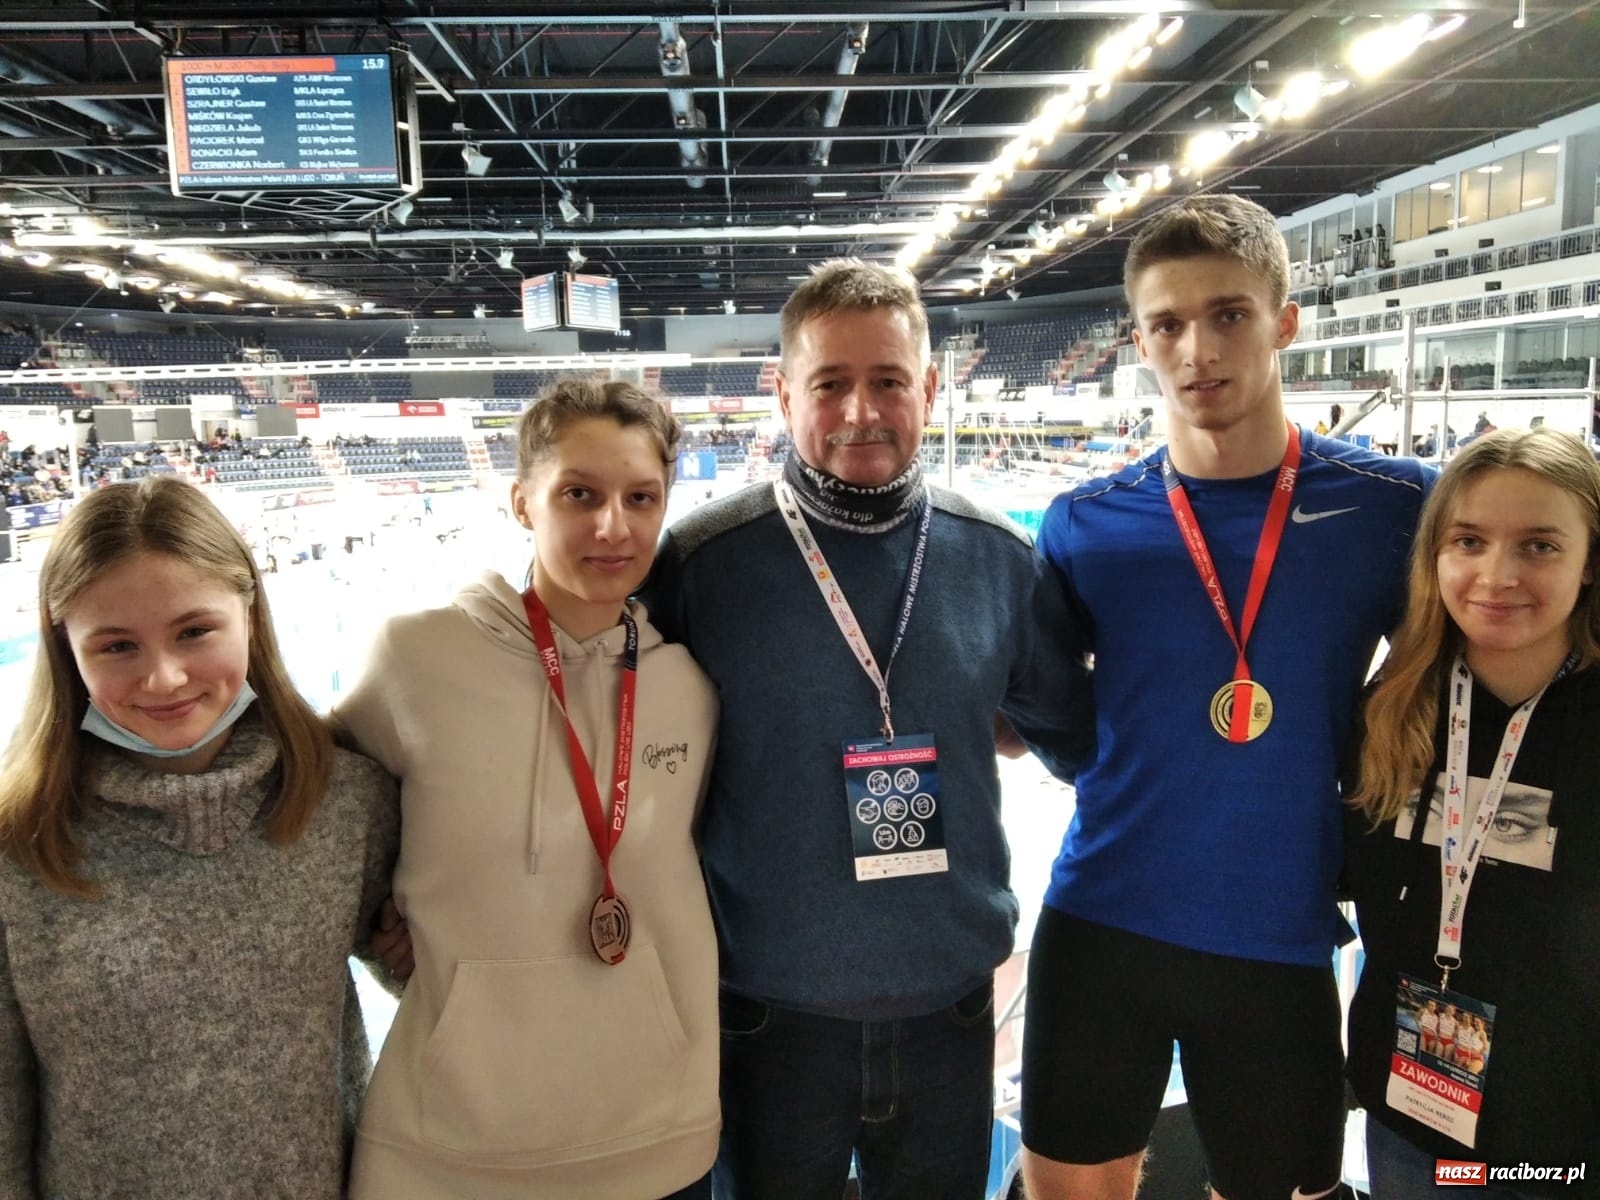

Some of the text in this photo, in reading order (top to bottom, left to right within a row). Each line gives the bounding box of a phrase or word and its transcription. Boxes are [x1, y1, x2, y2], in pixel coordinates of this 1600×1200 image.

[253, 160, 286, 169] Norbert
[1281, 466, 1297, 492] MCC
[899, 594, 914, 639] HALOWE
[909, 535, 928, 595] MISTRZOSTWA
[1207, 577, 1228, 621] PZLA
[543, 646, 560, 677] MCC
[848, 750, 933, 764] ZACHOWAJ OSTROŻNOŚĆ
[613, 779, 627, 832] PZLA
[1399, 1060, 1471, 1106] ZAWODNIK
